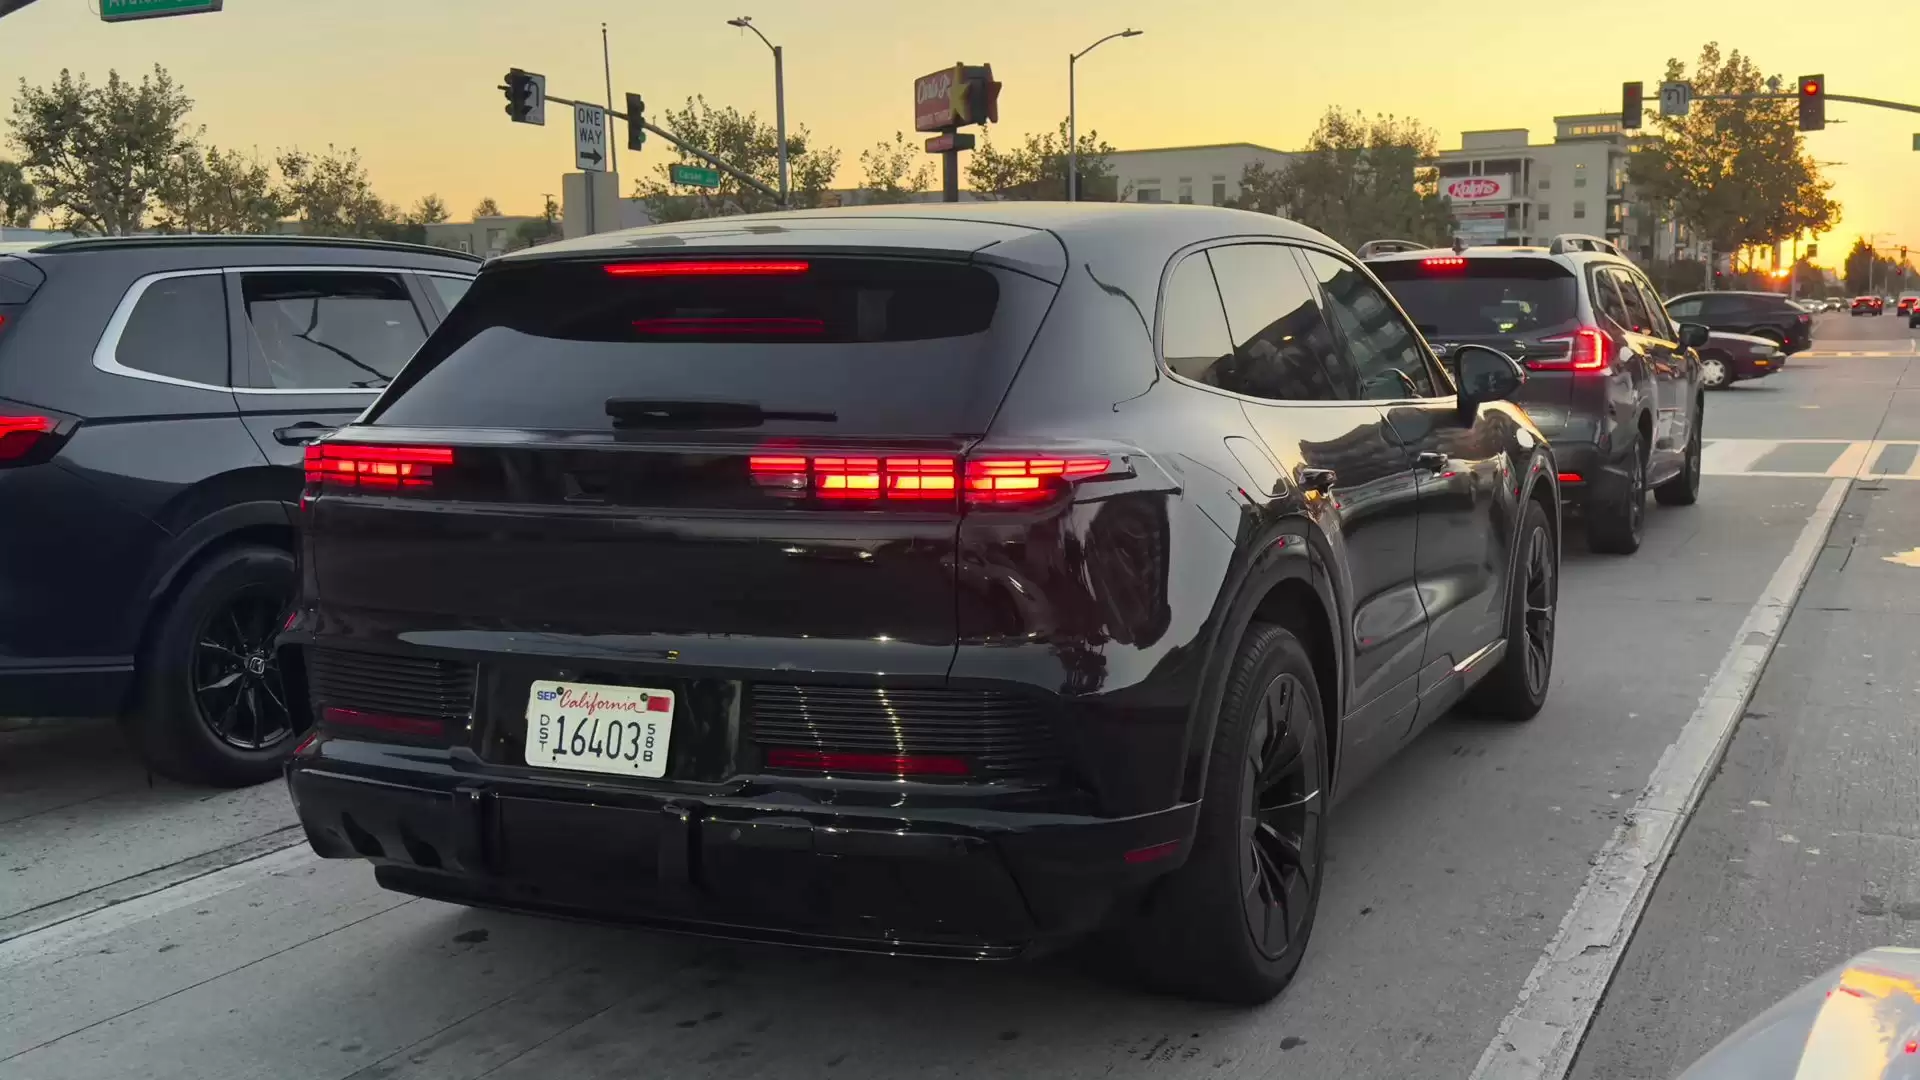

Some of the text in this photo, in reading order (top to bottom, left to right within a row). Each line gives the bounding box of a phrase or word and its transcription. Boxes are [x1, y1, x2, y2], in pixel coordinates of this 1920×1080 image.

[578, 107, 601, 127] ONE
[580, 127, 603, 145] WAY
[1451, 179, 1497, 198] Ralphs
[536, 690, 557, 701] SEP
[559, 689, 645, 715] California
[552, 715, 641, 761] 16403
